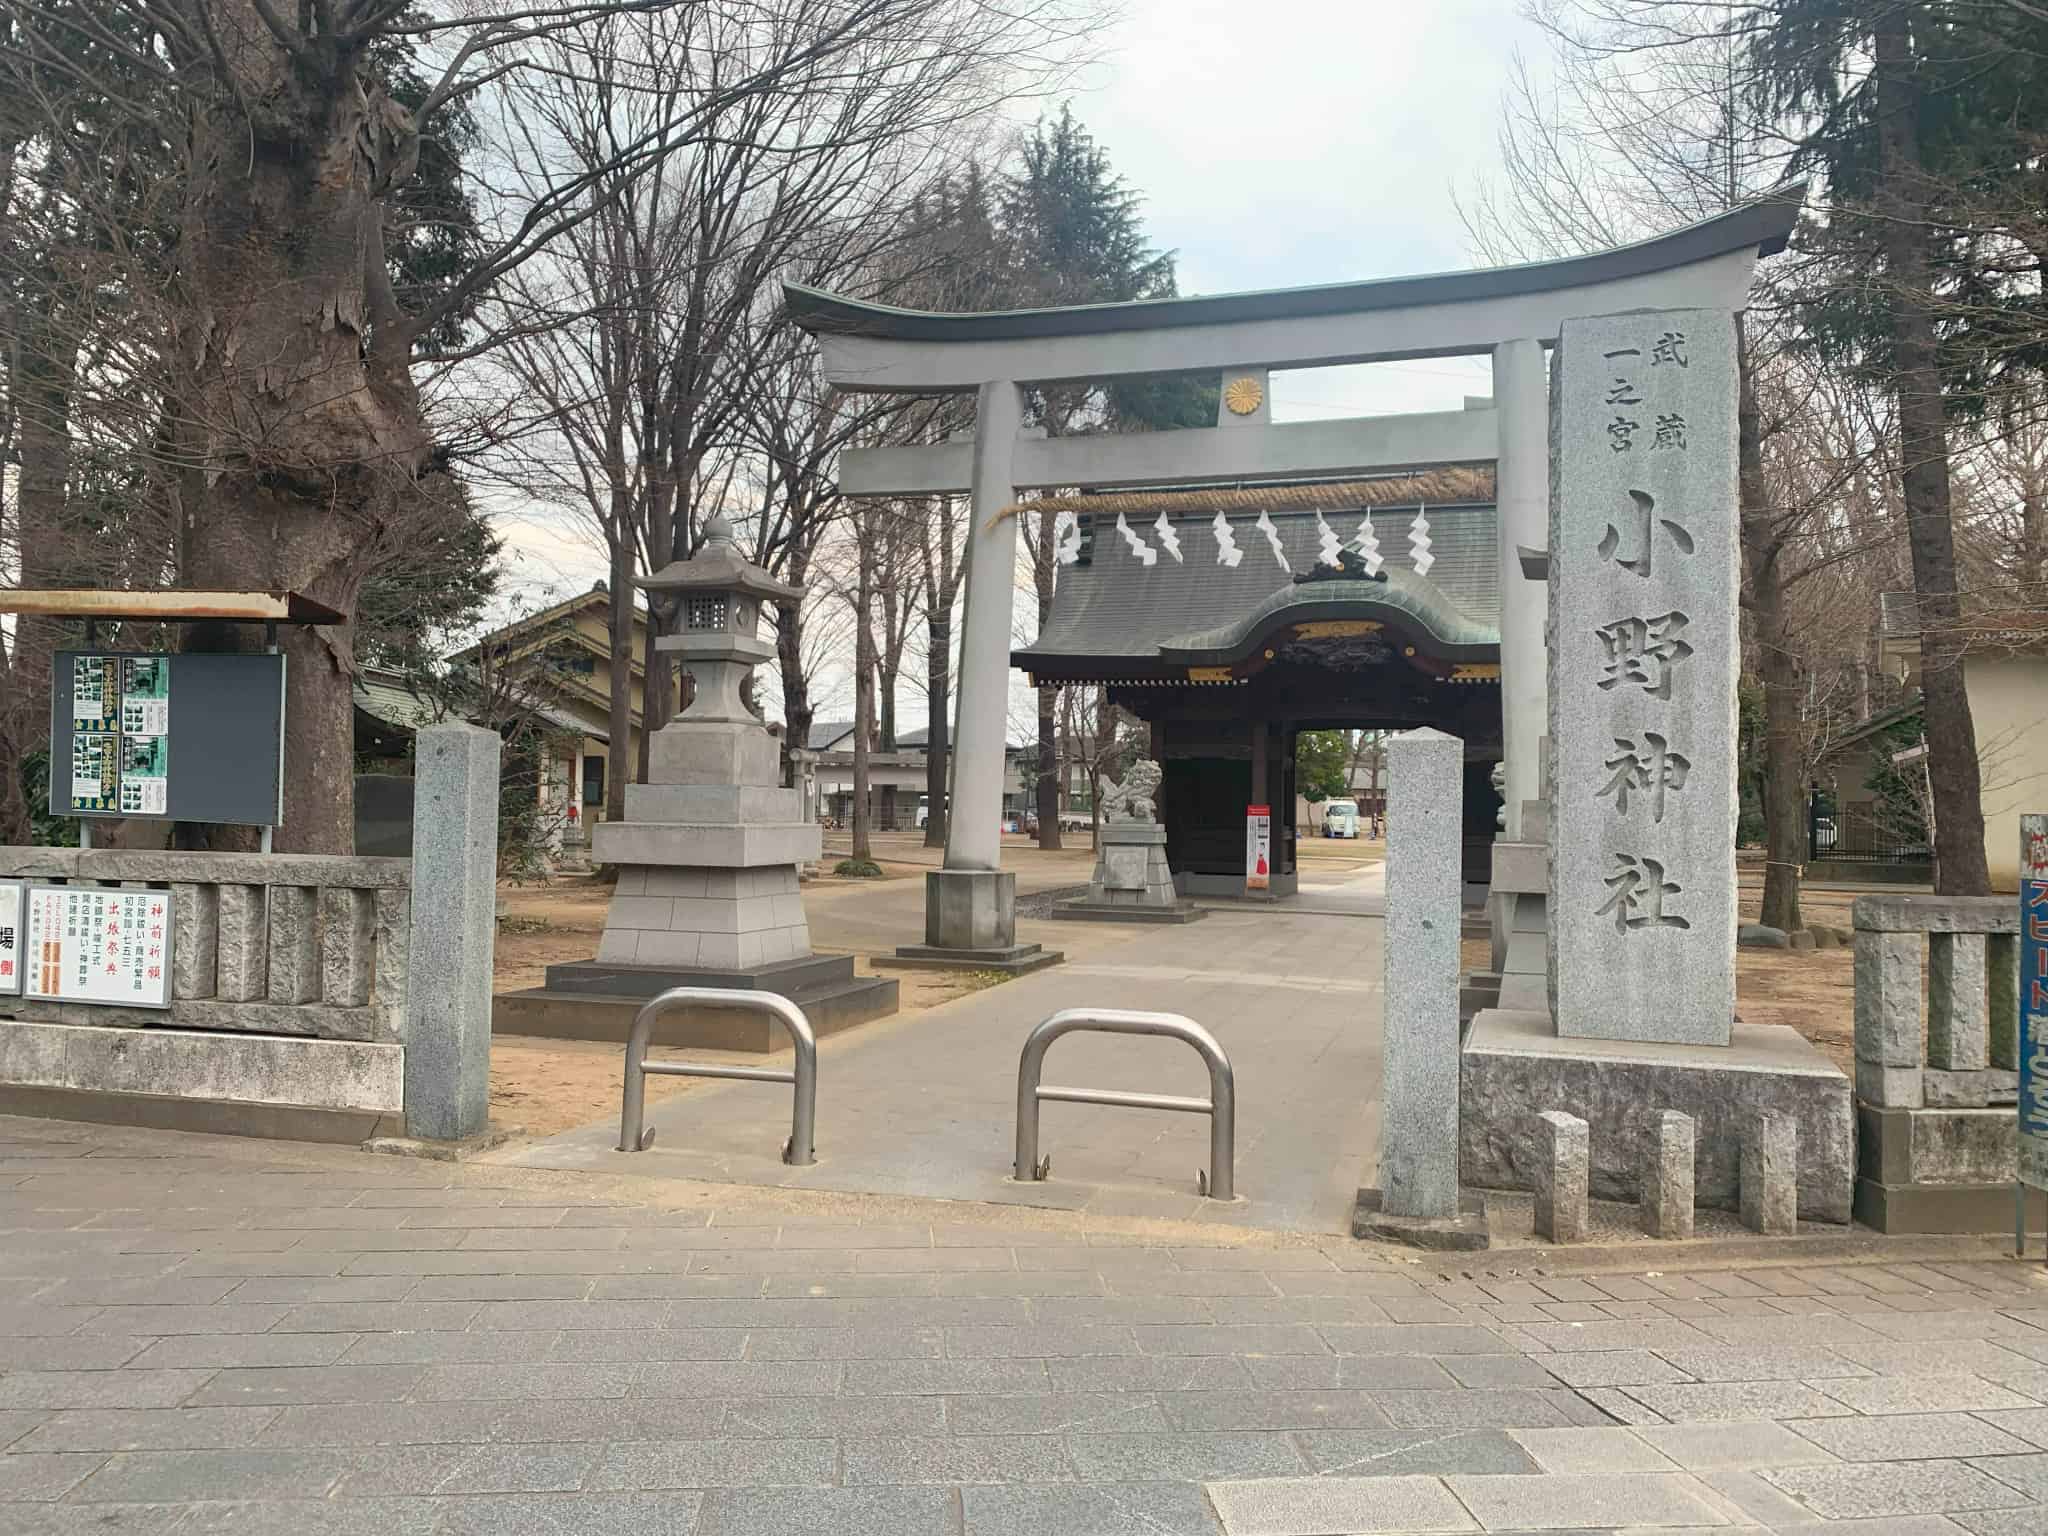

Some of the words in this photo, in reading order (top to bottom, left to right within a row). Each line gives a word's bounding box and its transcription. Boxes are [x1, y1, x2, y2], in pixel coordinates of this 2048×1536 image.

[1603, 345, 1643, 456] 一之宮
[1649, 331, 1689, 453] 武蔵
[1594, 488, 1696, 937] 小野神社
[106, 901, 120, 976] 出張祭典
[147, 903, 163, 980] 神前祈願
